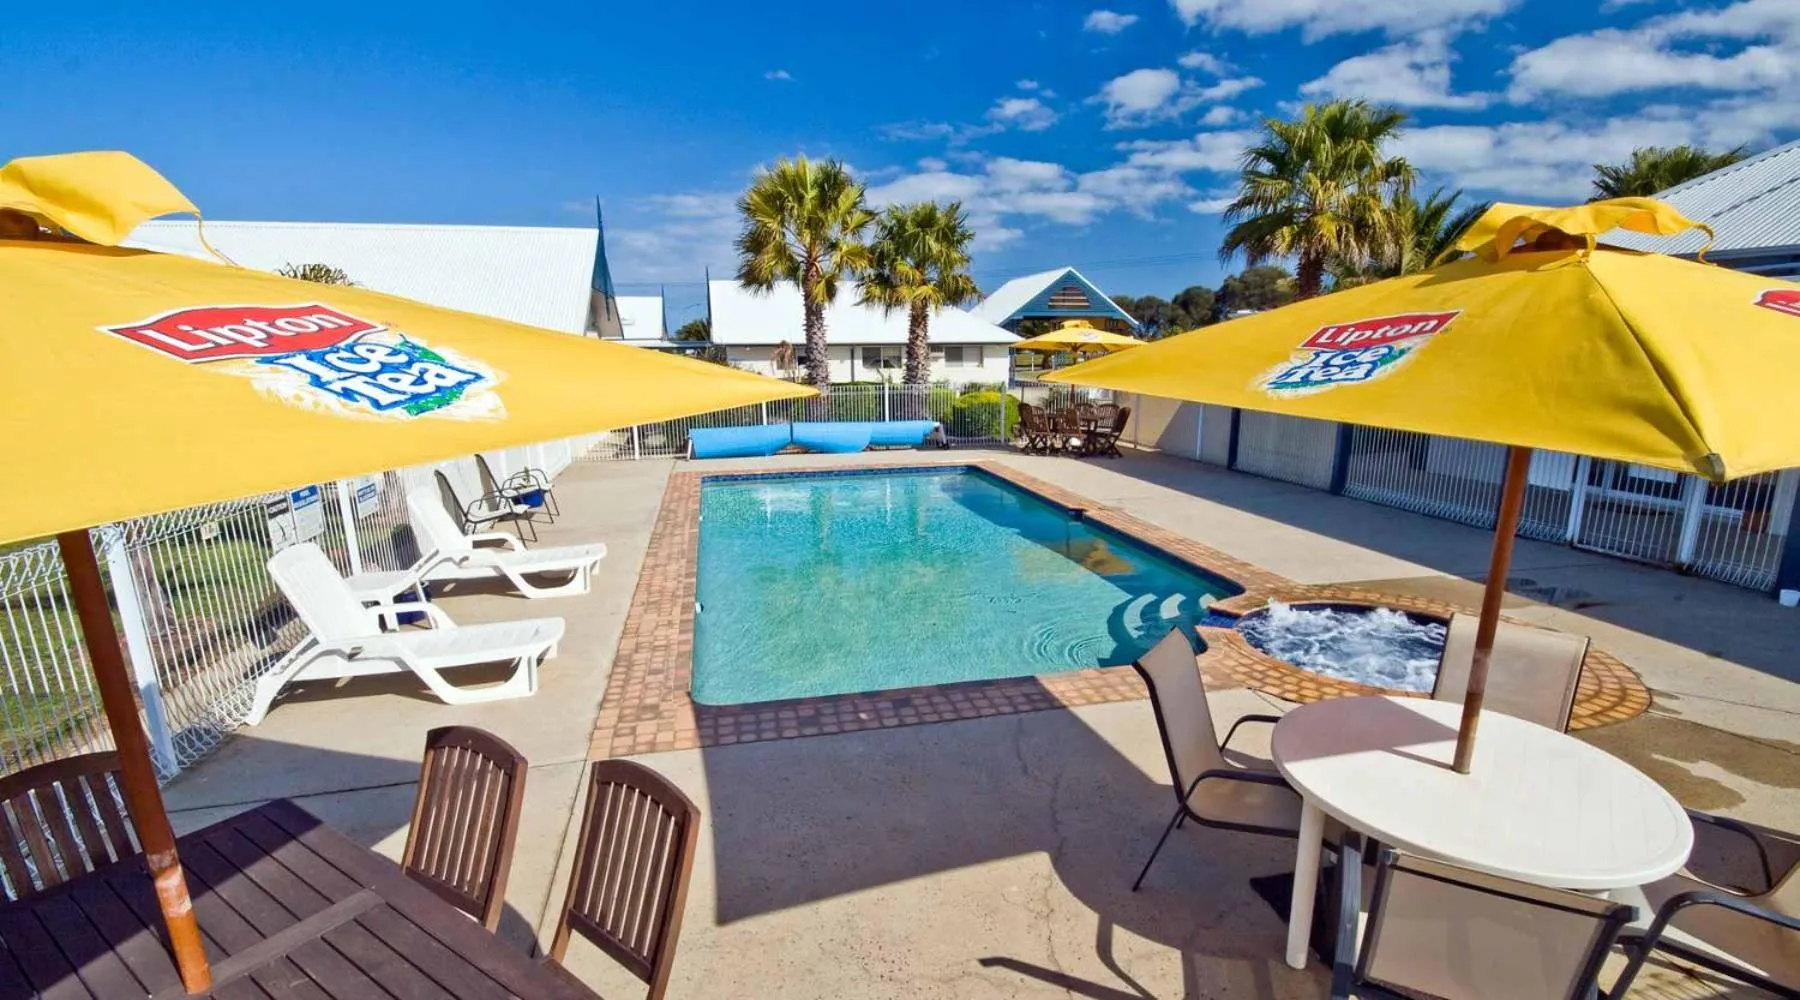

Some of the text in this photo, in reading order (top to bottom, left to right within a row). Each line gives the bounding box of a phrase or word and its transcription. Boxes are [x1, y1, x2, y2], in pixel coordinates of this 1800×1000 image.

[137, 313, 354, 351] Lipton
[1316, 318, 1439, 346] Lipton
[273, 343, 409, 382] Ice
[1311, 345, 1390, 367] Ice
[330, 361, 478, 405] Tea
[1272, 363, 1373, 384] Tea
